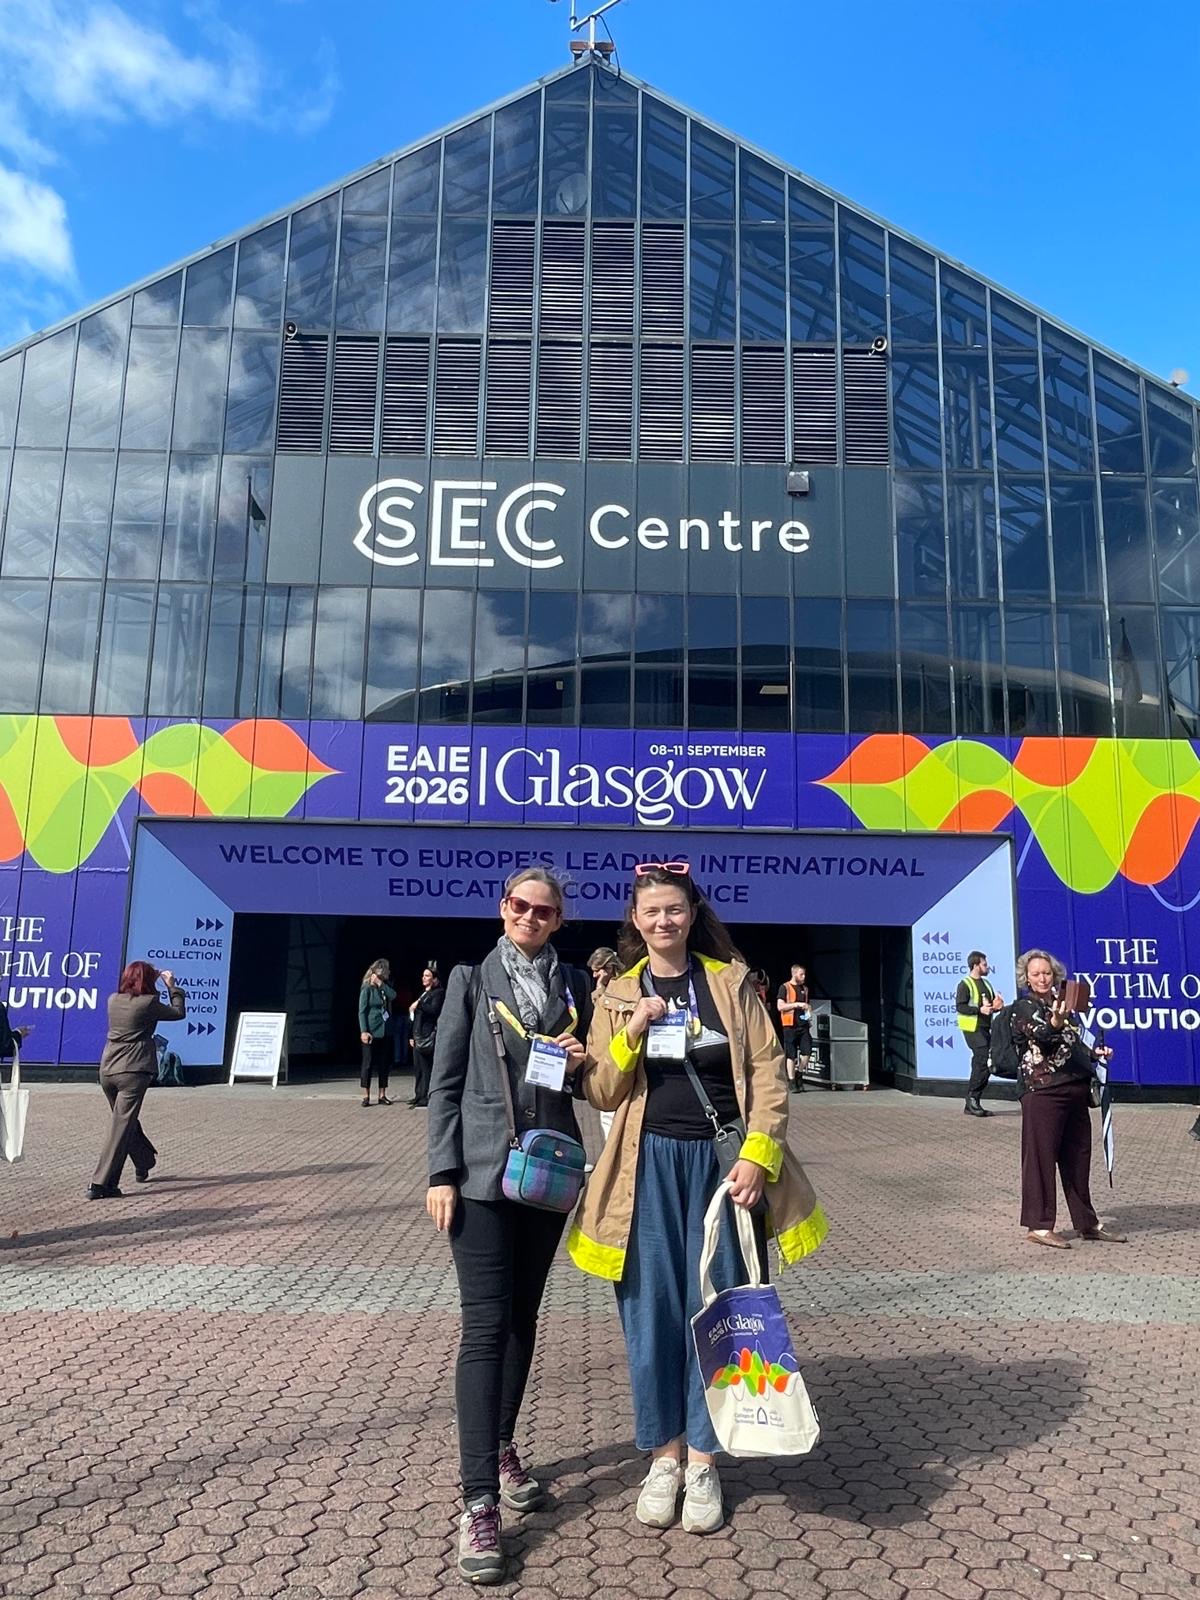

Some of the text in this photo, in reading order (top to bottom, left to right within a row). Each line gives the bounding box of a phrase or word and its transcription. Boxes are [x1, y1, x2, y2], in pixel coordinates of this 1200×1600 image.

[353, 478, 811, 569] SEC Centre
[387, 745, 470, 772] EAIE
[687, 745, 766, 757] SEPTEMBER
[385, 777, 469, 805] 2026
[494, 747, 767, 826] Glasgow
[219, 844, 362, 866] WELCOME
[371, 848, 409, 868] TO
[419, 849, 554, 870] EUROPE'S
[700, 854, 925, 877] INTERNATIONAL
[389, 878, 749, 903] EDUCATI CONFNCE
[147, 950, 222, 960] COLLECTION
[183, 938, 223, 948] BADGE
[1096, 938, 1159, 964] THE
[61, 952, 101, 978] OF
[922, 952, 962, 961] BADGE
[2, 987, 98, 1009] UTION
[923, 991, 957, 1000] WALK
[1073, 972, 1200, 999] YTHM O
[1079, 1007, 1200, 1030] VOLUTIO
